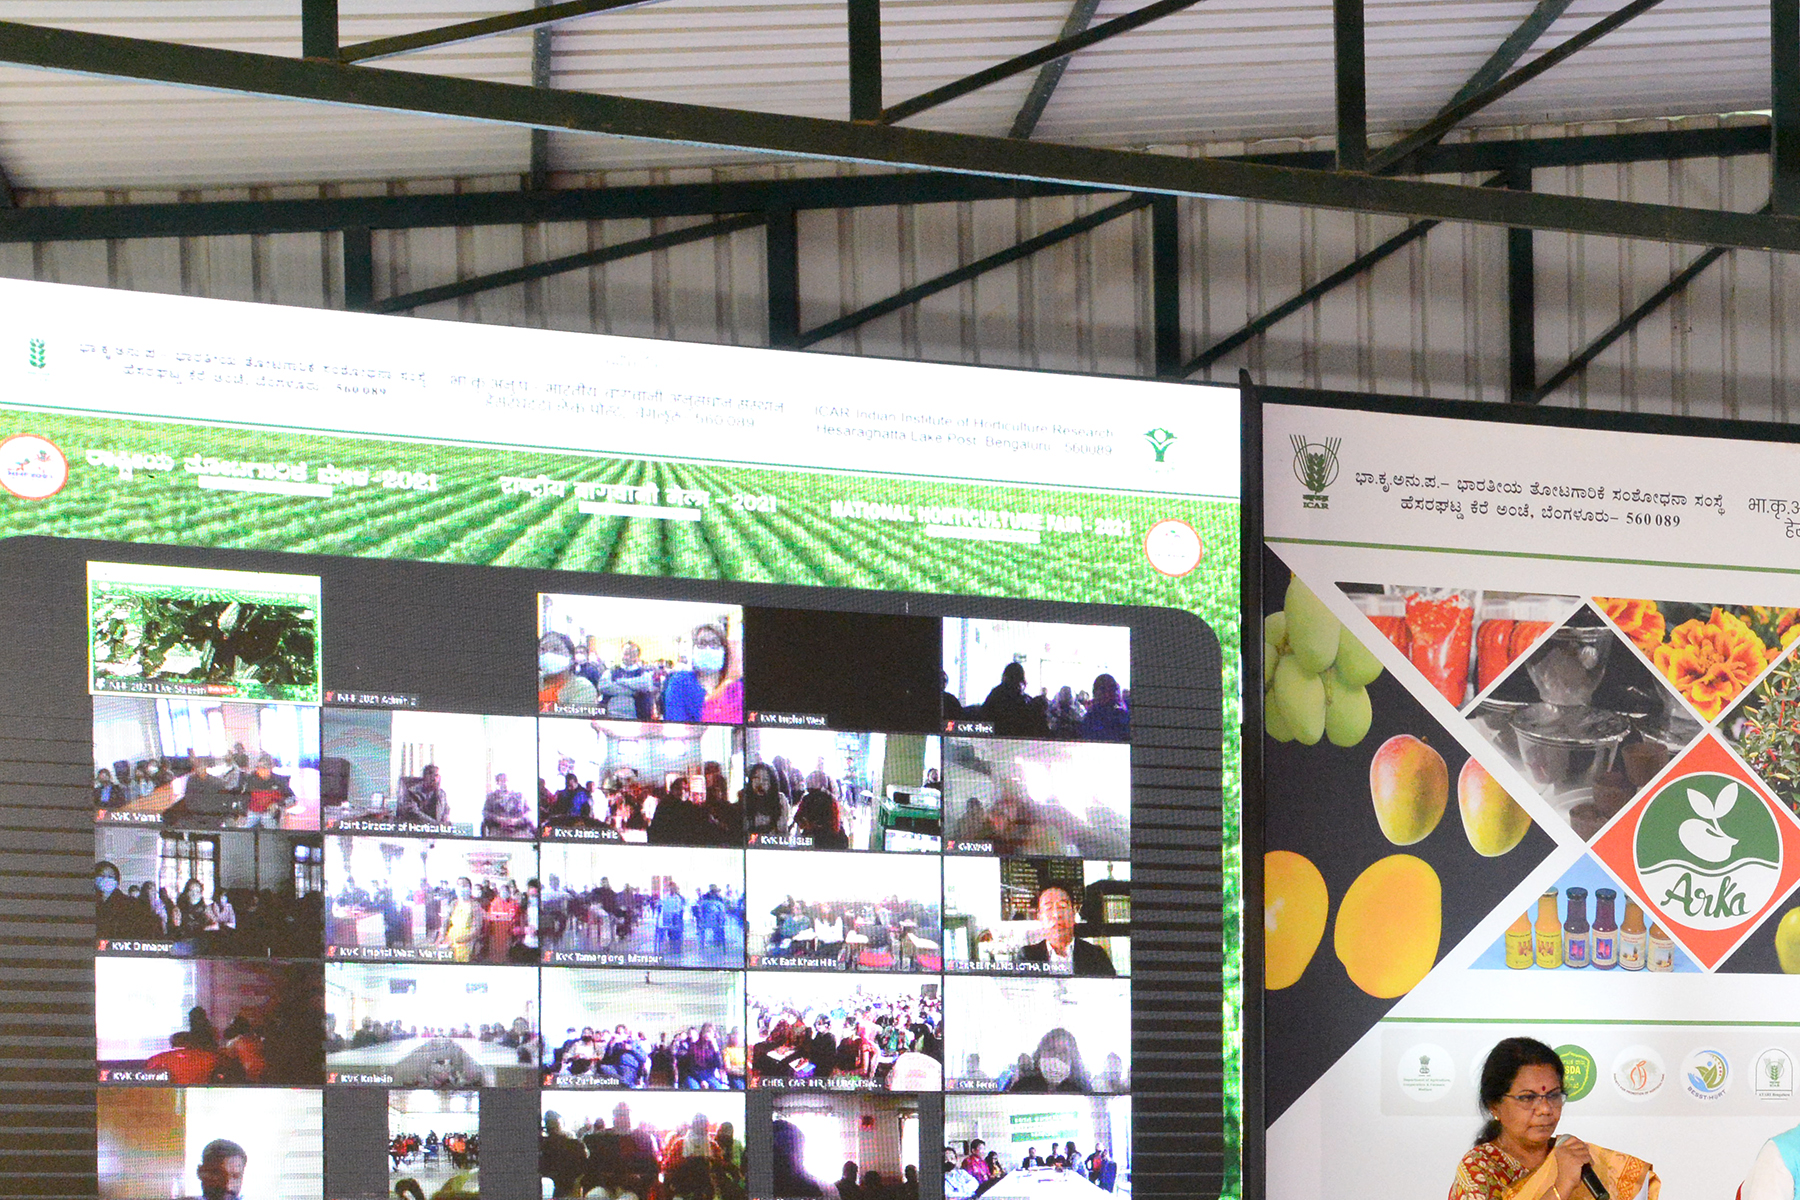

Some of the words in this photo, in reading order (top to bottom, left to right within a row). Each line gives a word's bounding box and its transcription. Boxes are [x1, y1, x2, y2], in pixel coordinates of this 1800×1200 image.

[1303, 502, 1329, 510] ICAR
[1400, 496, 1465, 520] ಹೆಸರಘಟ್ಟ
[1470, 500, 1489, 515] ಕೆರೆ
[1626, 512, 1651, 526] 560
[1655, 514, 1681, 528] 089
[1457, 477, 1522, 495] ಭಾರತೀಯ
[1529, 481, 1605, 500] ತೋಟಗಾರಿಕೆ
[1612, 488, 1688, 507] ಸಂಶೋಧನಾ
[1694, 494, 1726, 516] ಸಂಸ್ಥೆ
[1660, 872, 1751, 918] Arka
[1564, 1065, 1582, 1075] SDA
